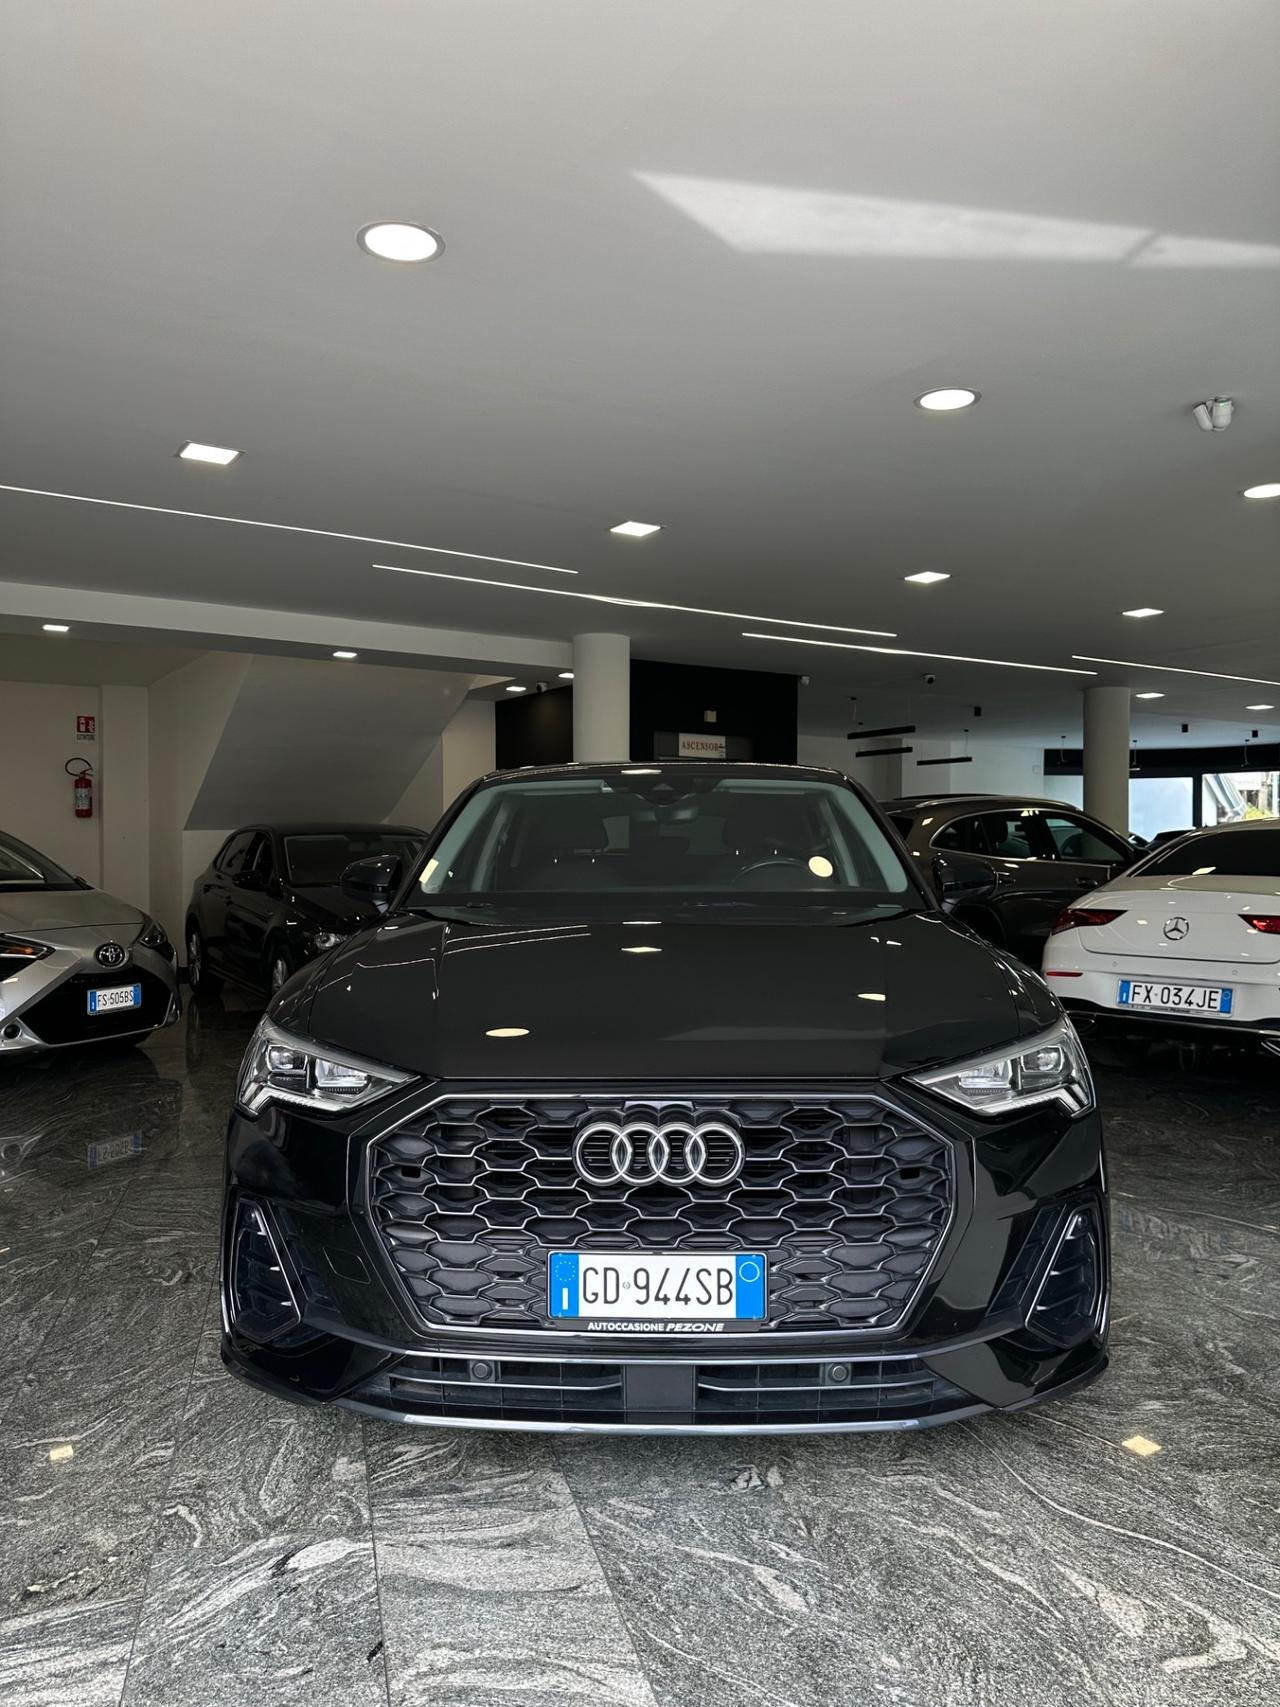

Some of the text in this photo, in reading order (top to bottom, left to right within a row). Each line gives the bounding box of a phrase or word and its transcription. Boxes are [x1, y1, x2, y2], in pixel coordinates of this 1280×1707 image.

[1131, 984, 1154, 1004] FX
[1160, 986, 1220, 1010] 034JE
[561, 1266, 734, 1310] I GD 944SB
[587, 1321, 725, 1332] AUTOCCASIONE PEZONE
